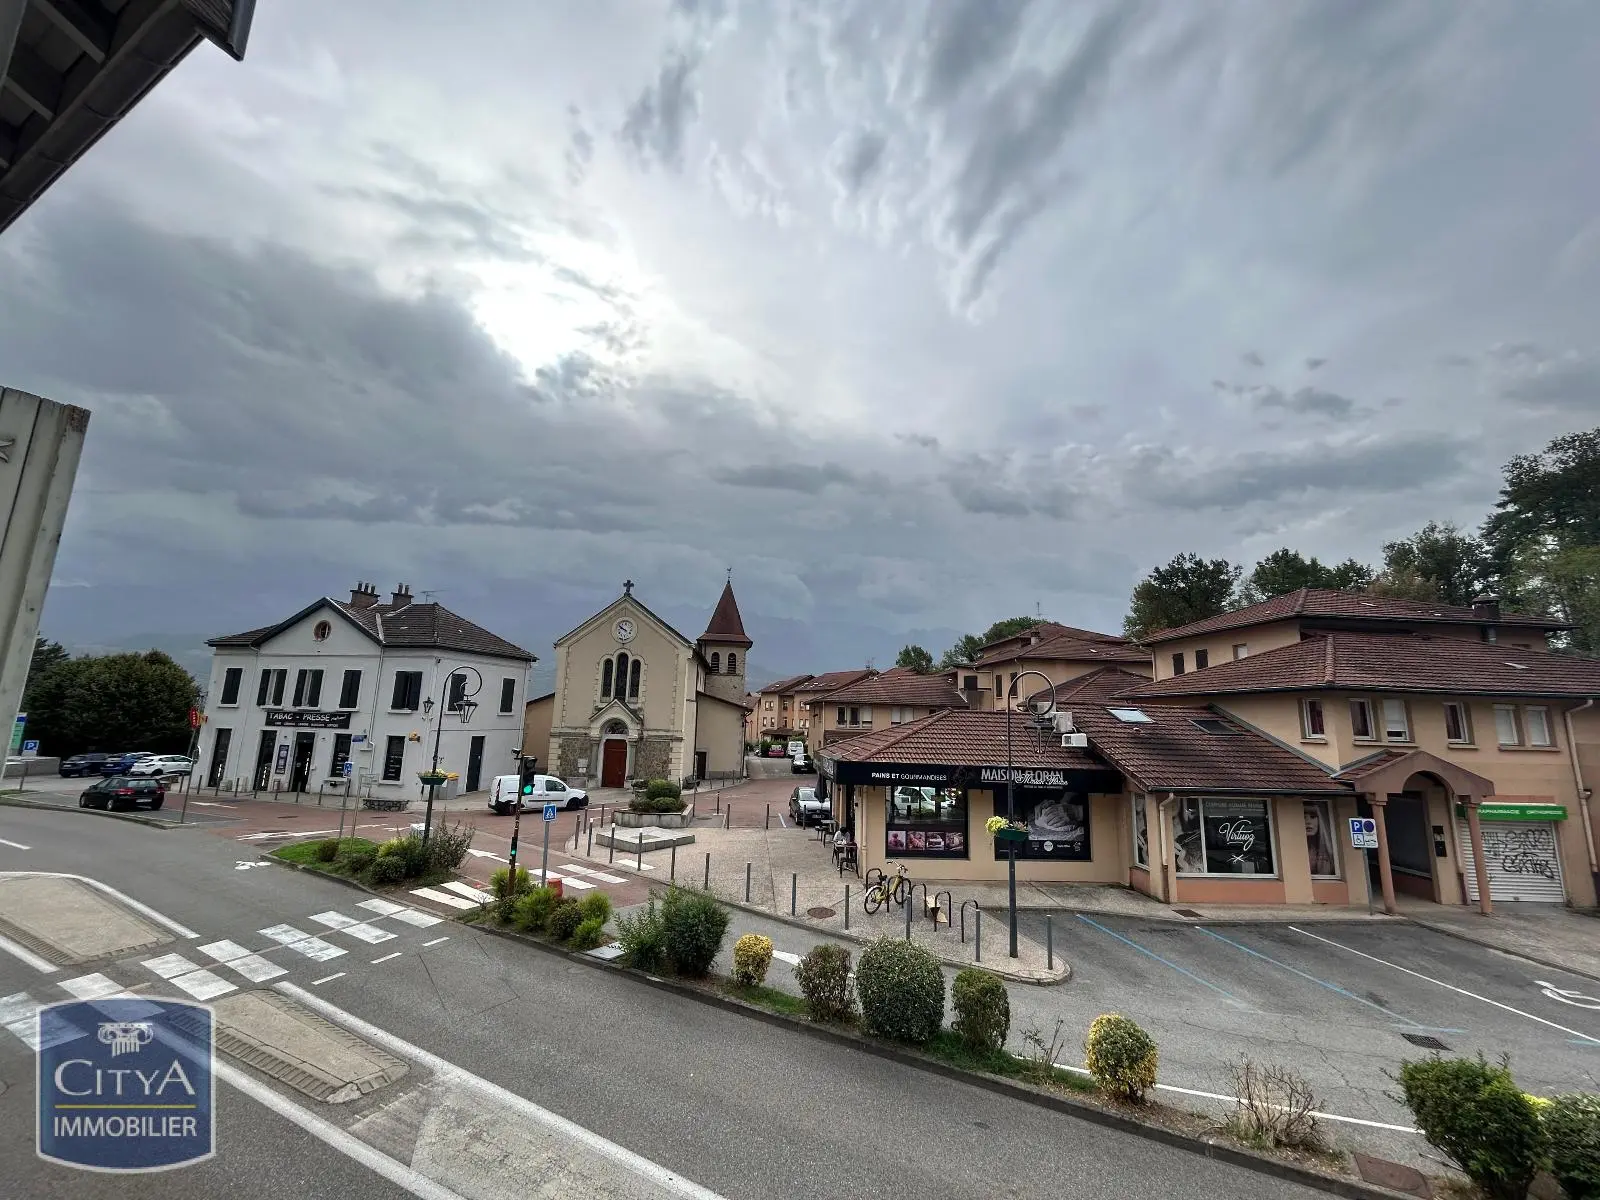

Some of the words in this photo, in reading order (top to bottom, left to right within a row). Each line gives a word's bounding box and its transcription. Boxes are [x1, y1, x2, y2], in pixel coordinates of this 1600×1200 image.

[269, 712, 293, 720] TABAC
[302, 713, 330, 722] PRESSE
[900, 773, 947, 781] GOURMANDISES
[981, 768, 1021, 781] MAISON
[1353, 821, 1361, 831] P
[1218, 819, 1256, 851] Virtuoz
